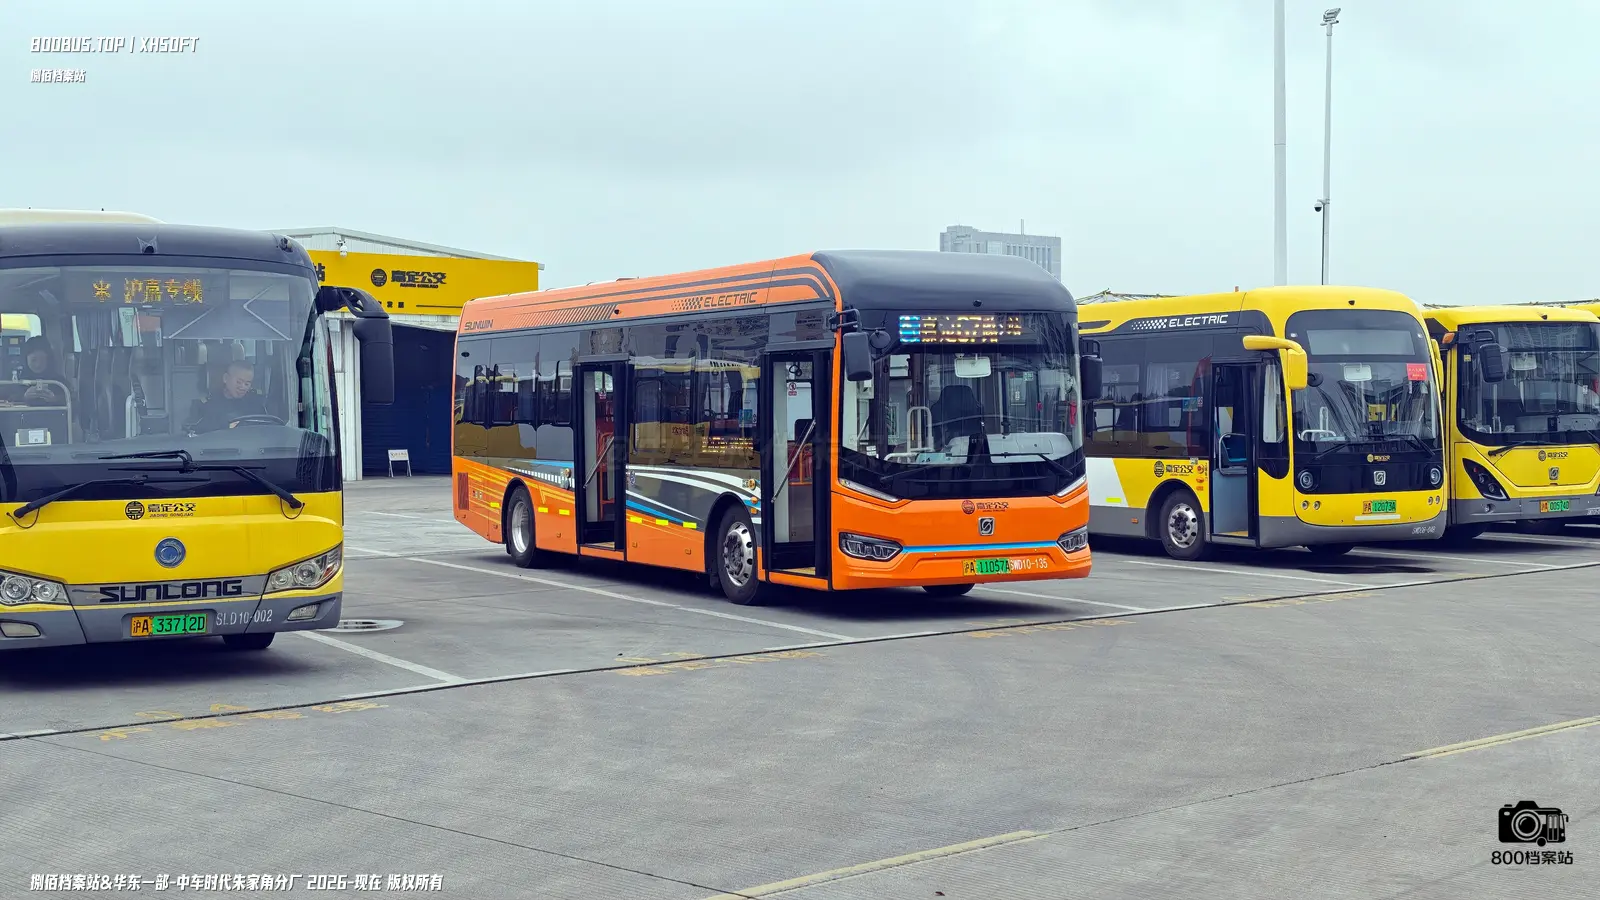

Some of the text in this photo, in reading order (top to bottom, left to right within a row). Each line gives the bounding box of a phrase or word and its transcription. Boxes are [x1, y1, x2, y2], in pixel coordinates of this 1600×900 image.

[391, 270, 447, 284] 嘉定公交
[124, 278, 203, 304] 沪嘉专线
[703, 291, 758, 308] ELECTRIC
[464, 318, 494, 331] SUNWIN
[1168, 313, 1229, 328] ELECTRIC
[147, 502, 197, 513] 嘉定公交
[99, 579, 243, 603] SUNLONG
[155, 615, 206, 633] 33712D
